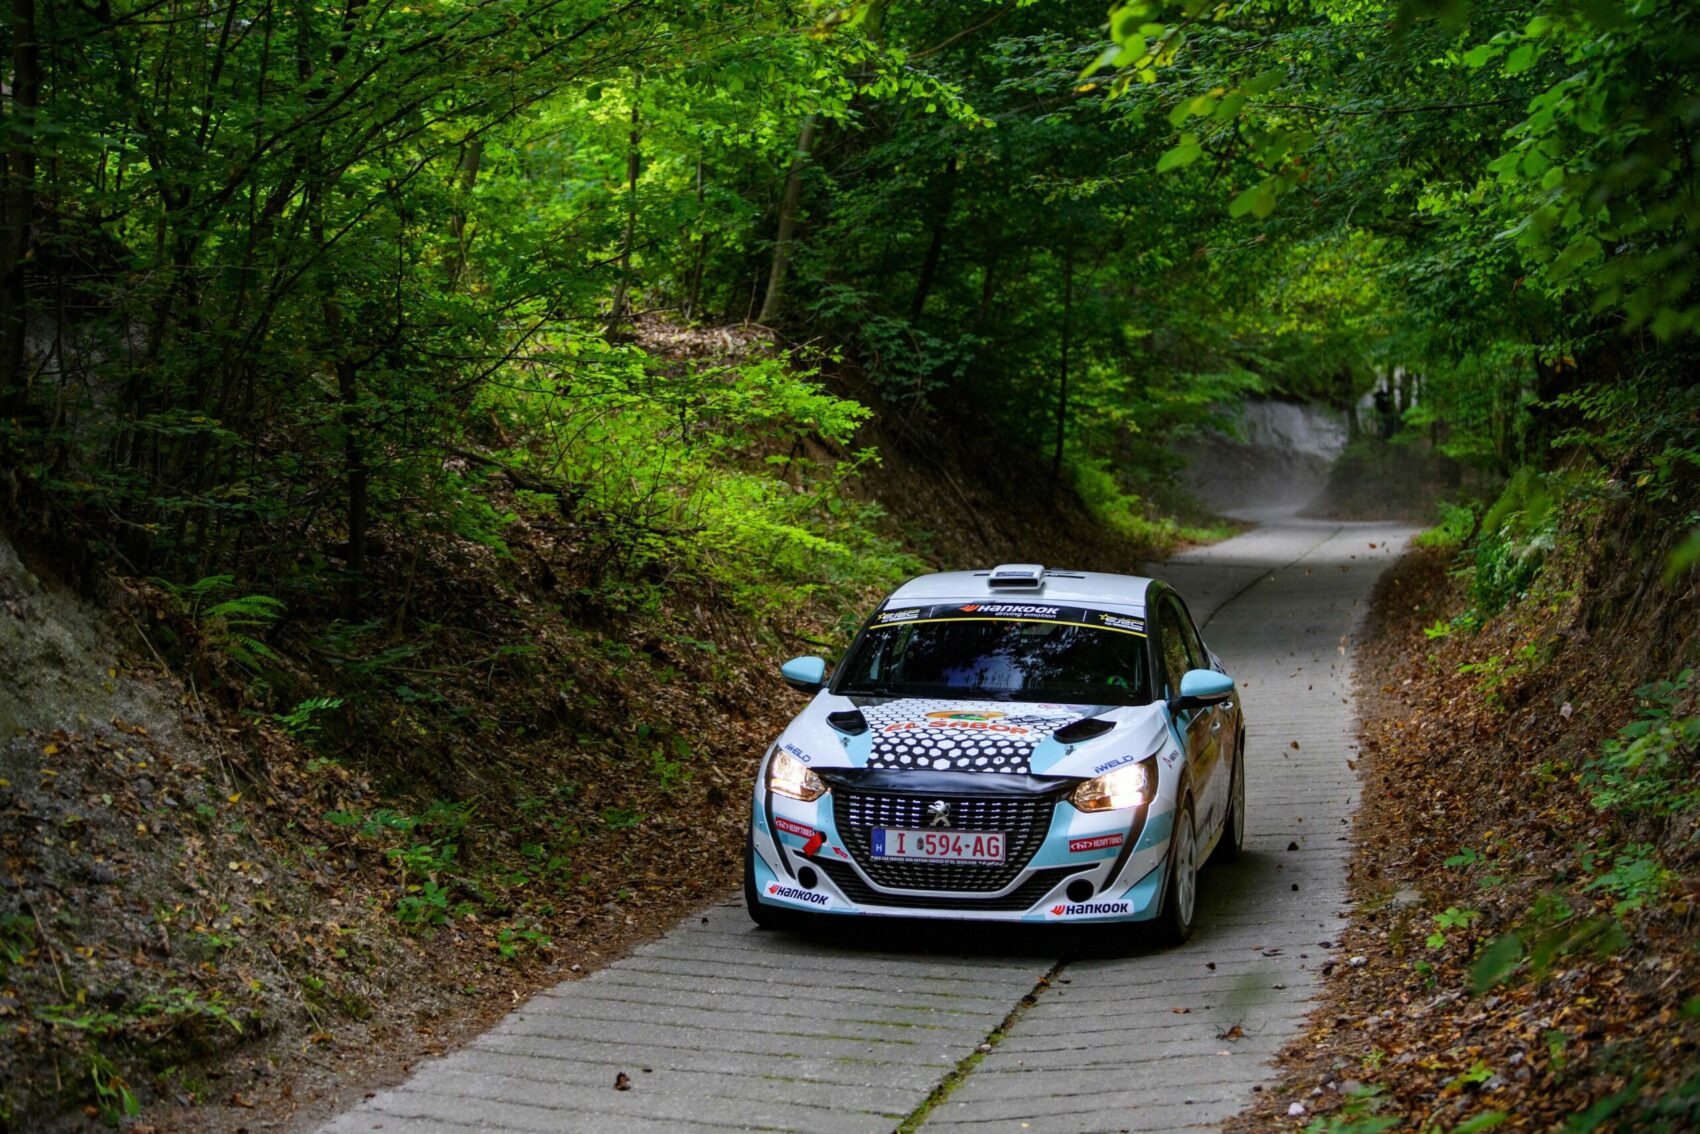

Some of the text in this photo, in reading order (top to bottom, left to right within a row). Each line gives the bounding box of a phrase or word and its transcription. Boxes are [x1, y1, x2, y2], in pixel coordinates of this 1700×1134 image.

[928, 720, 1029, 735] SABOR
[875, 843, 883, 852] H
[896, 832, 1000, 857] I 594-AG
[1093, 838, 1109, 848] HEAVY
[1108, 835, 1123, 845] TOOLS
